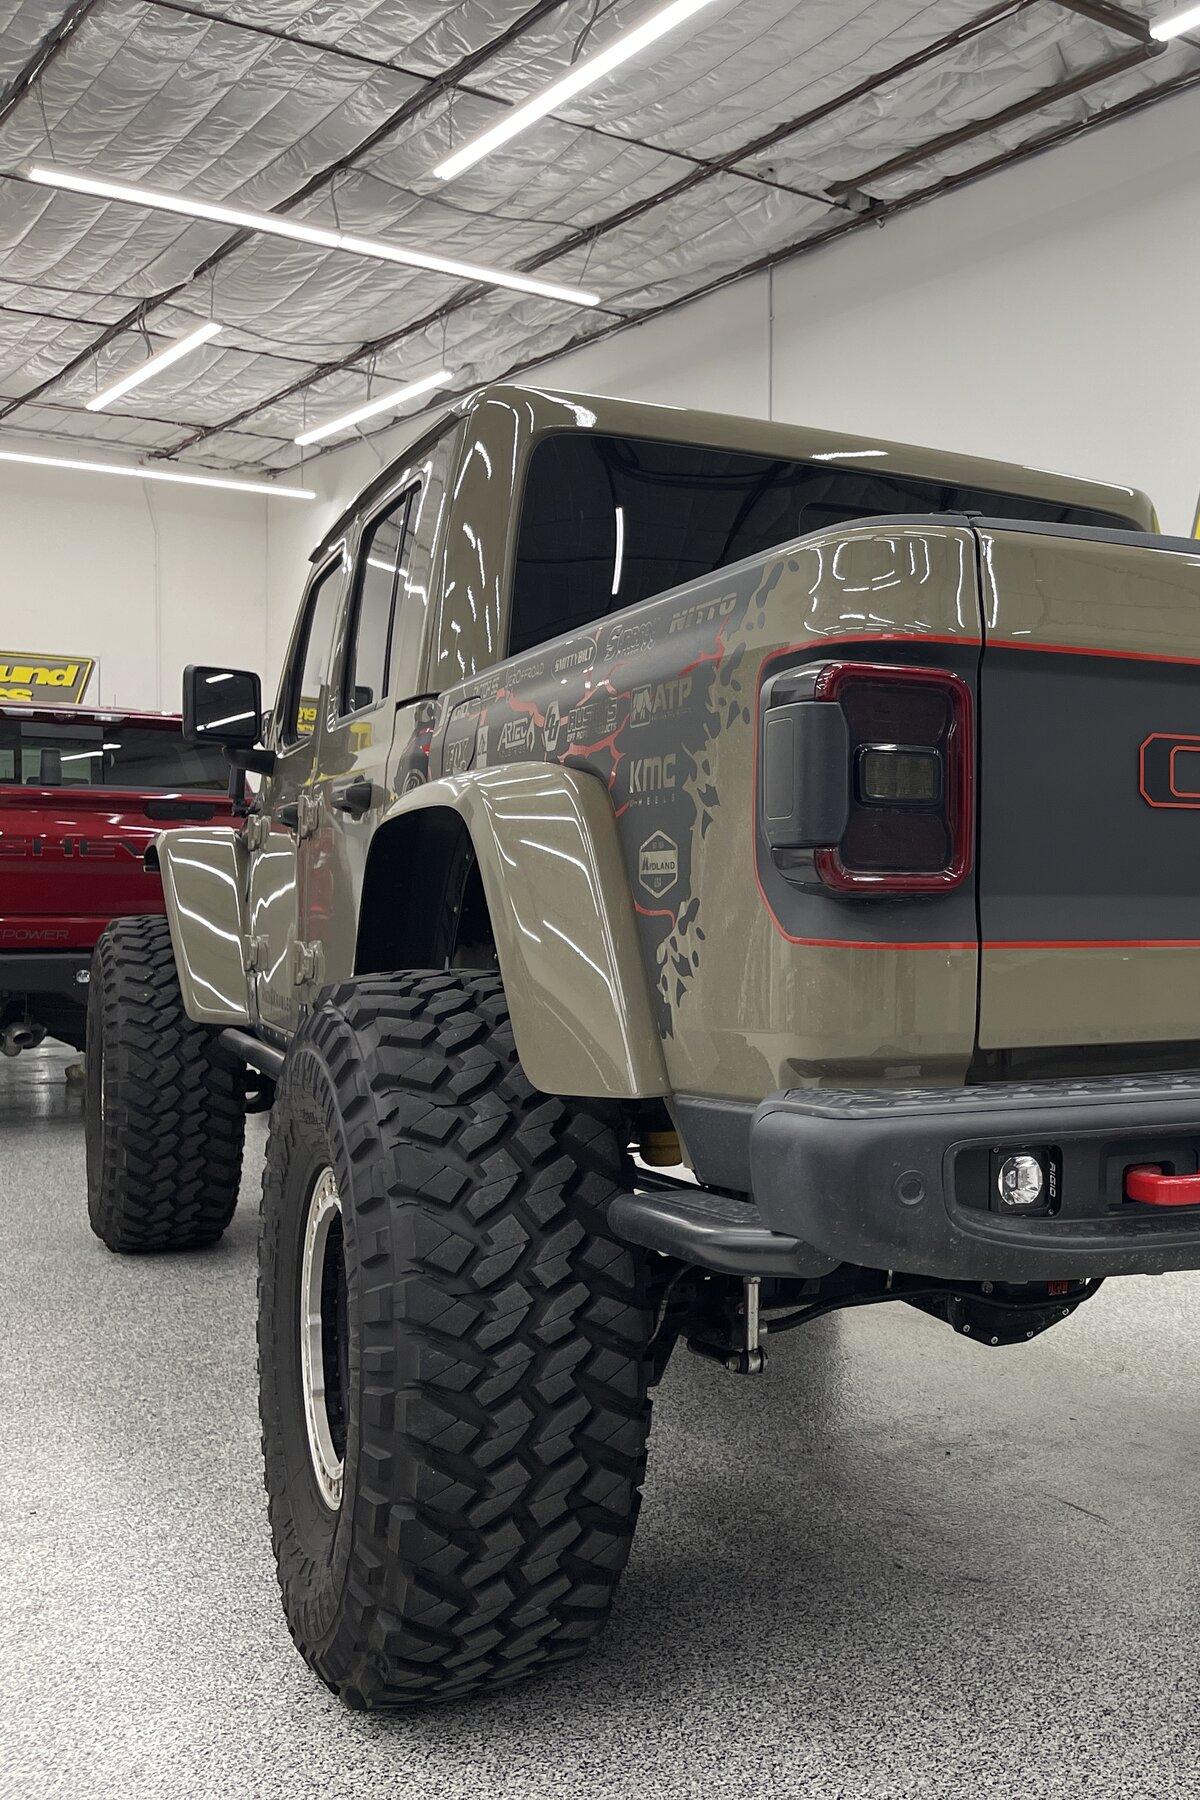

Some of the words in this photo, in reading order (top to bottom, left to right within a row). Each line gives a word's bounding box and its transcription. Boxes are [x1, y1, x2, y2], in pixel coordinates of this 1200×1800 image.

[652, 676, 692, 714] ATP
[629, 753, 677, 794] KMC
[0, 929, 70, 940] POWER
